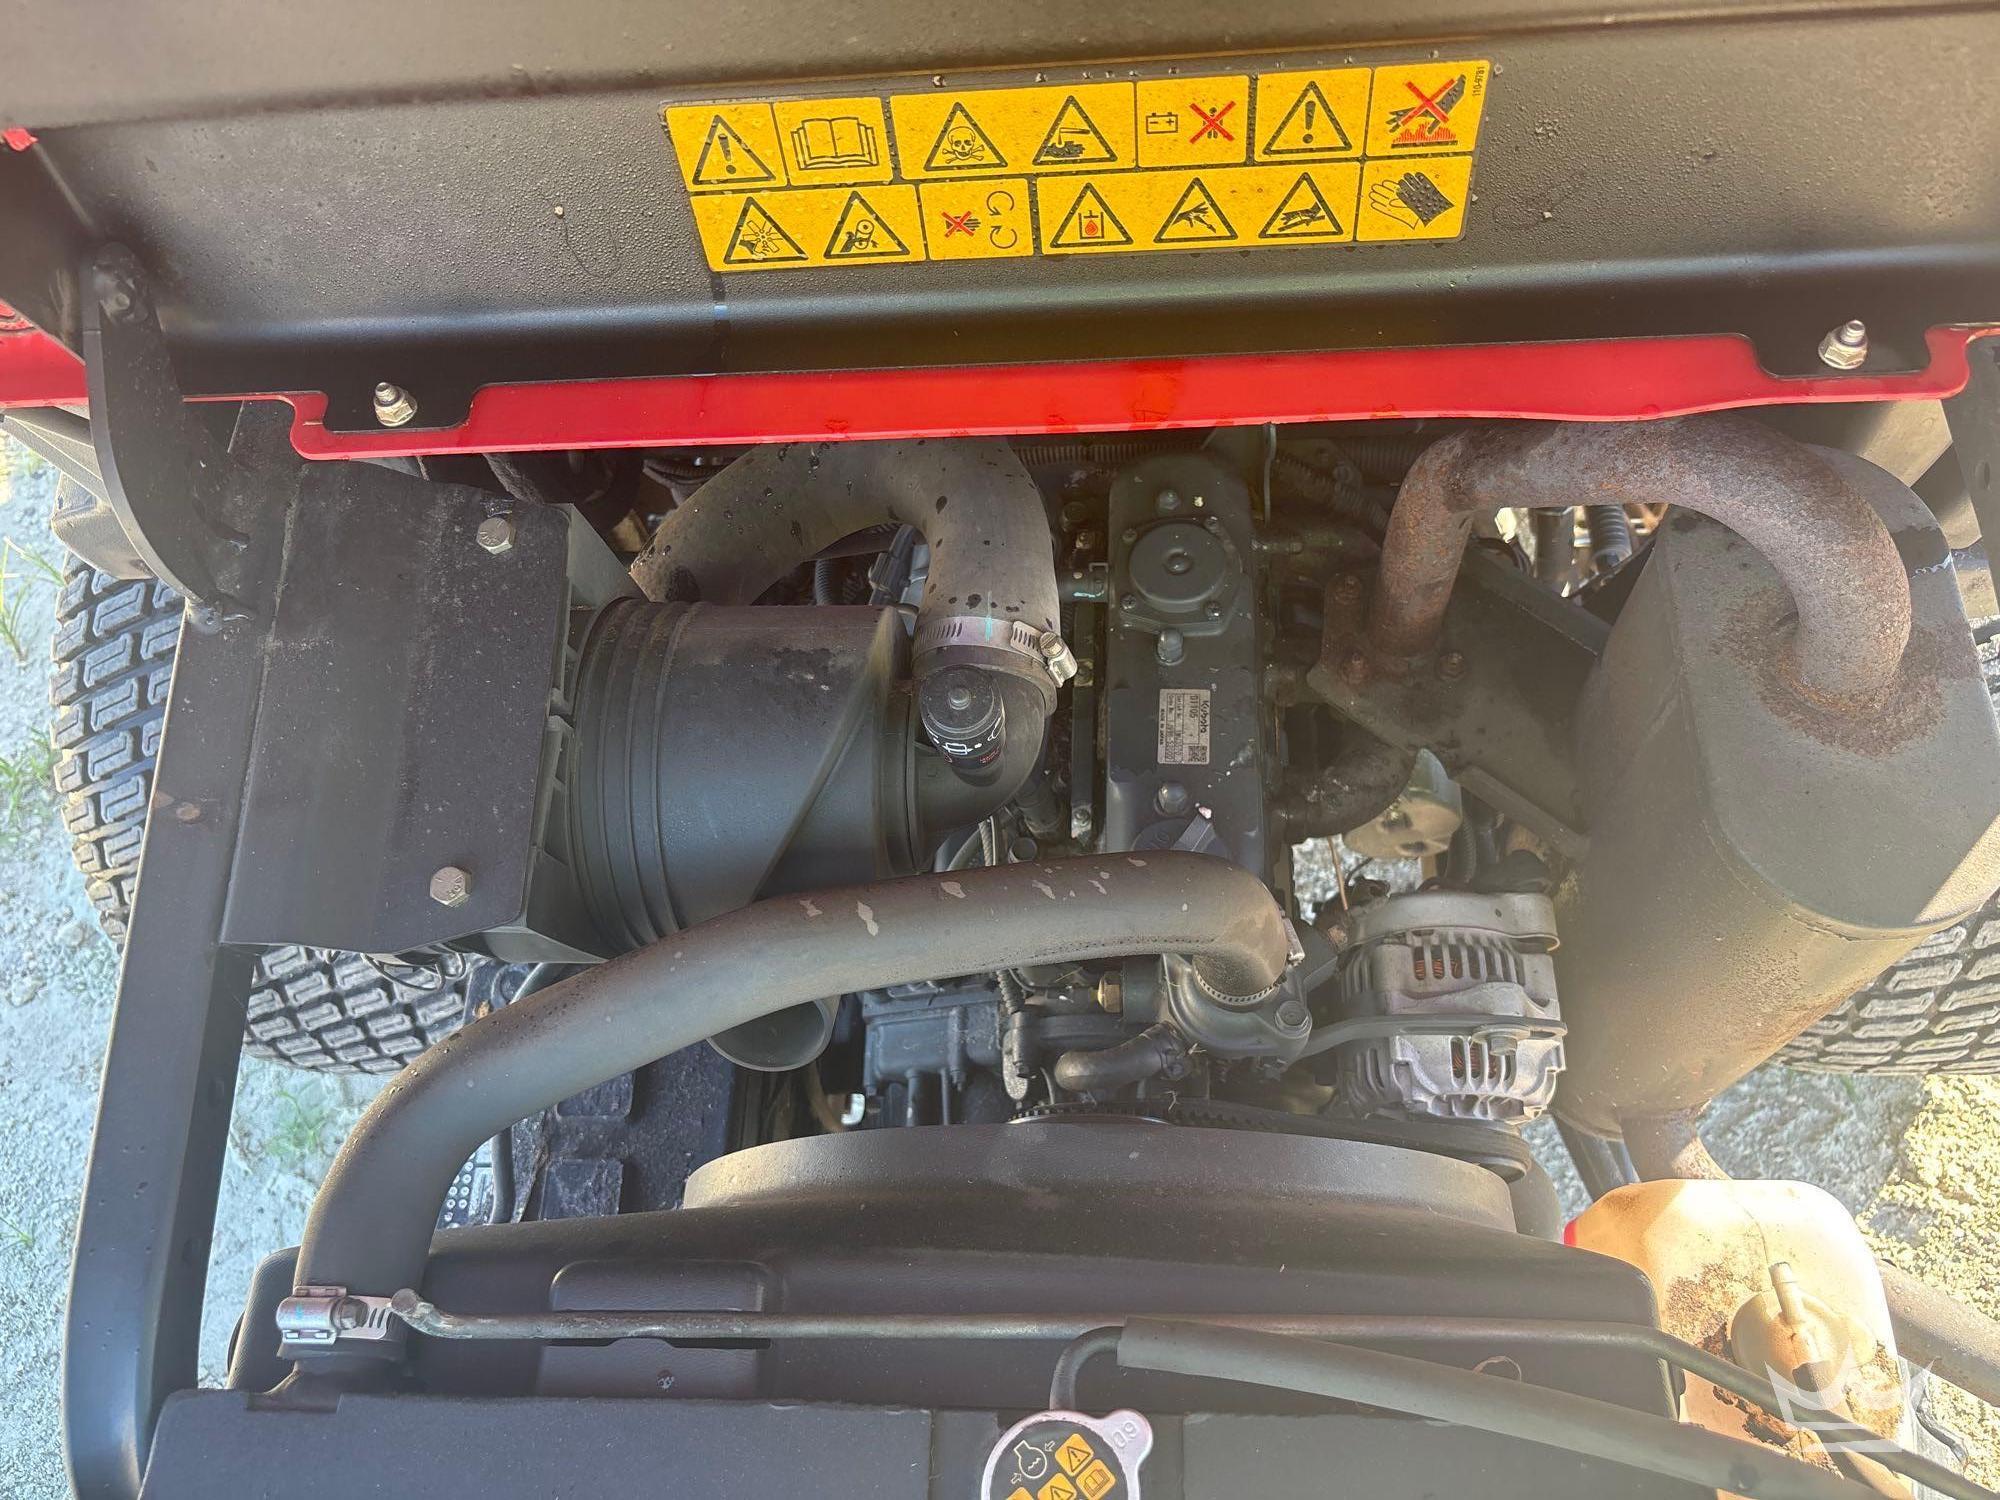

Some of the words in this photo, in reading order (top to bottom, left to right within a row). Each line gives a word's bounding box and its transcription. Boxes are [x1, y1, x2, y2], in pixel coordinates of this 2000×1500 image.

[1472, 66, 1485, 97] 110-9781
[1189, 695, 1198, 718] D1105
[1200, 700, 1209, 733] Kubota
